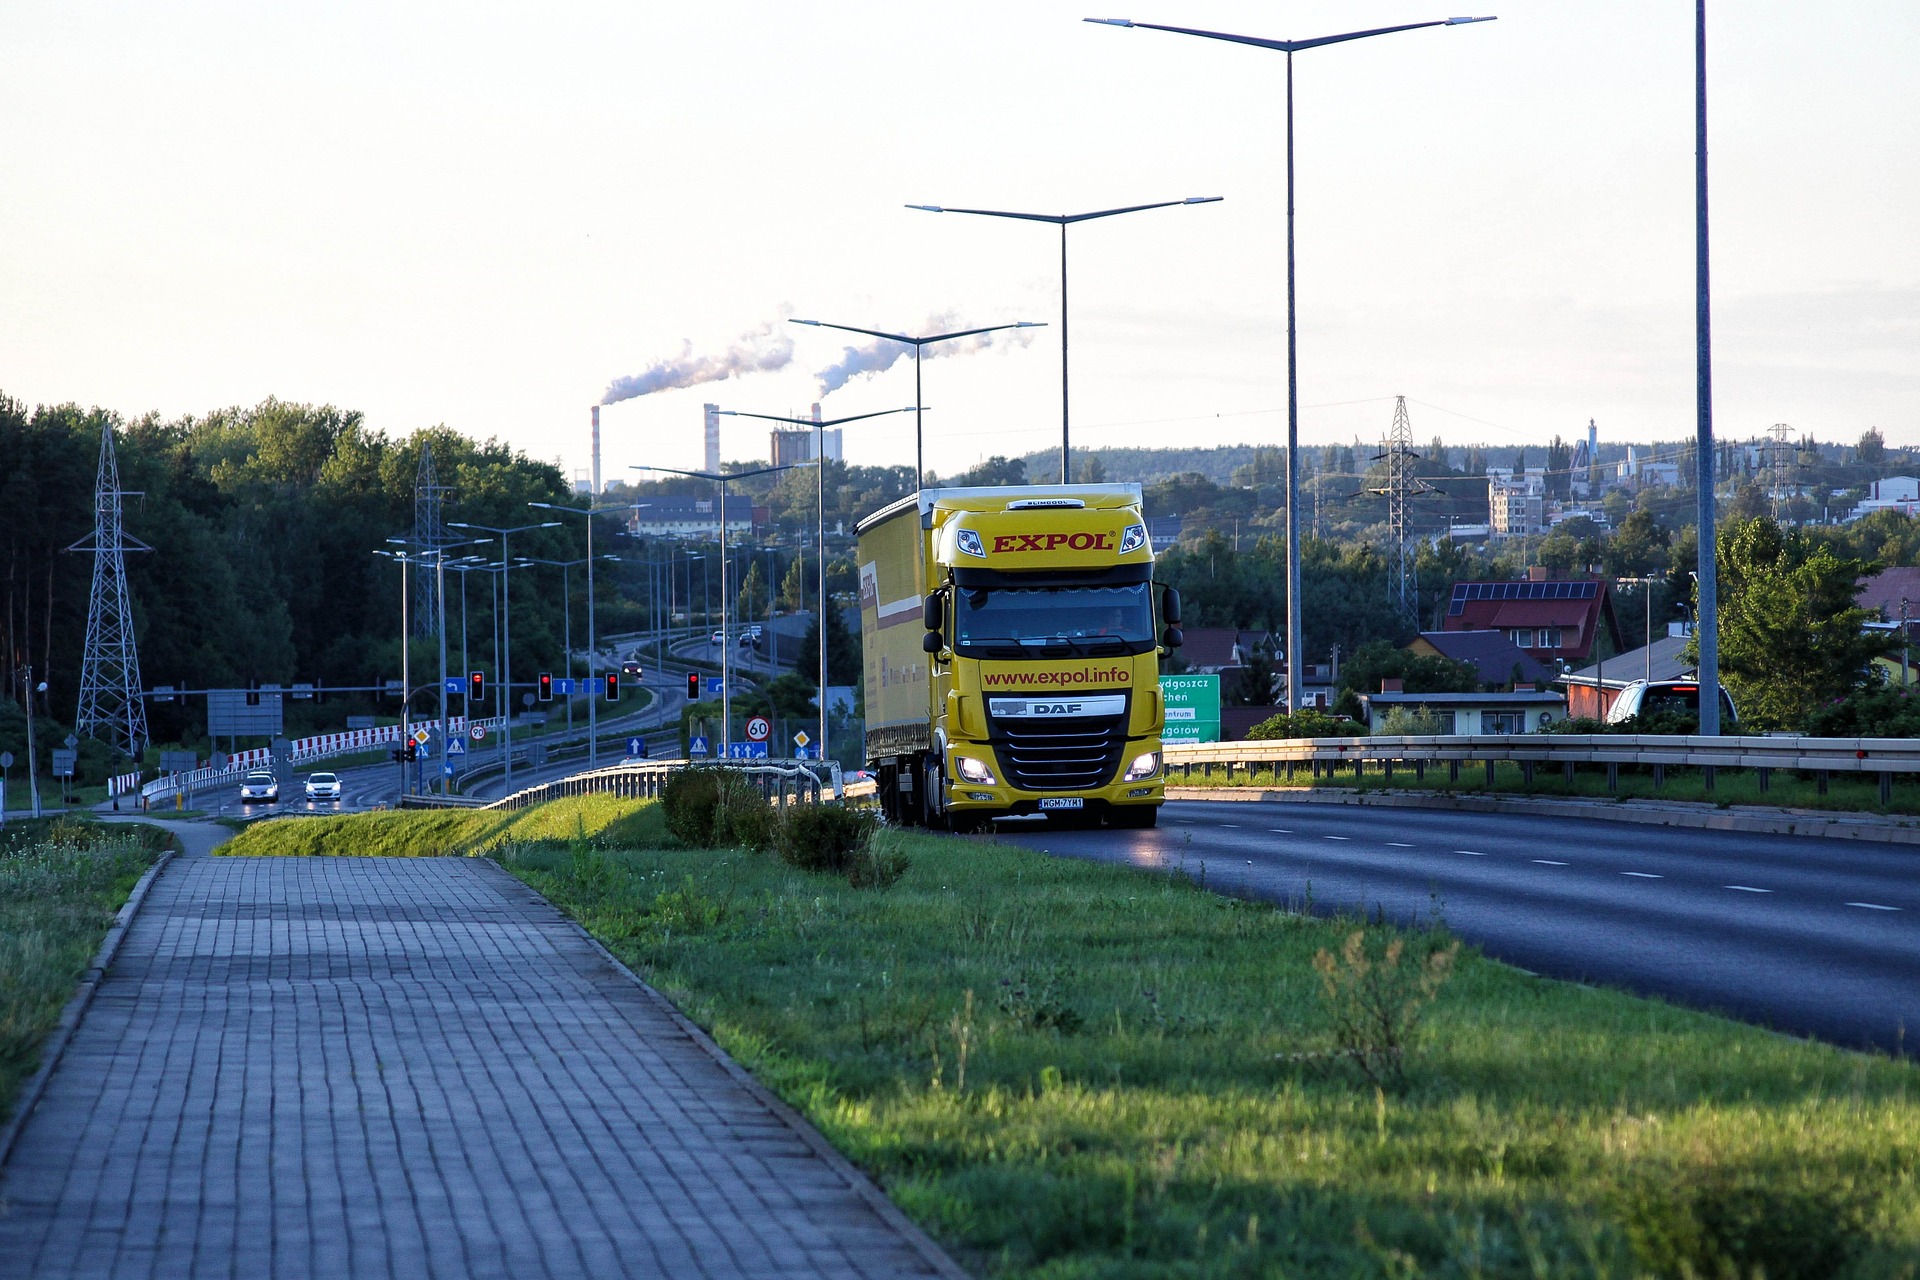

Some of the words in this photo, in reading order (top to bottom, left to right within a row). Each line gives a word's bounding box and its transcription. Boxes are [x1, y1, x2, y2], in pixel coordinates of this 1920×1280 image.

[992, 533, 1113, 553] EXPOL
[984, 667, 1130, 686] www.expol.info
[1034, 704, 1082, 714] DAF
[749, 722, 767, 735] 60
